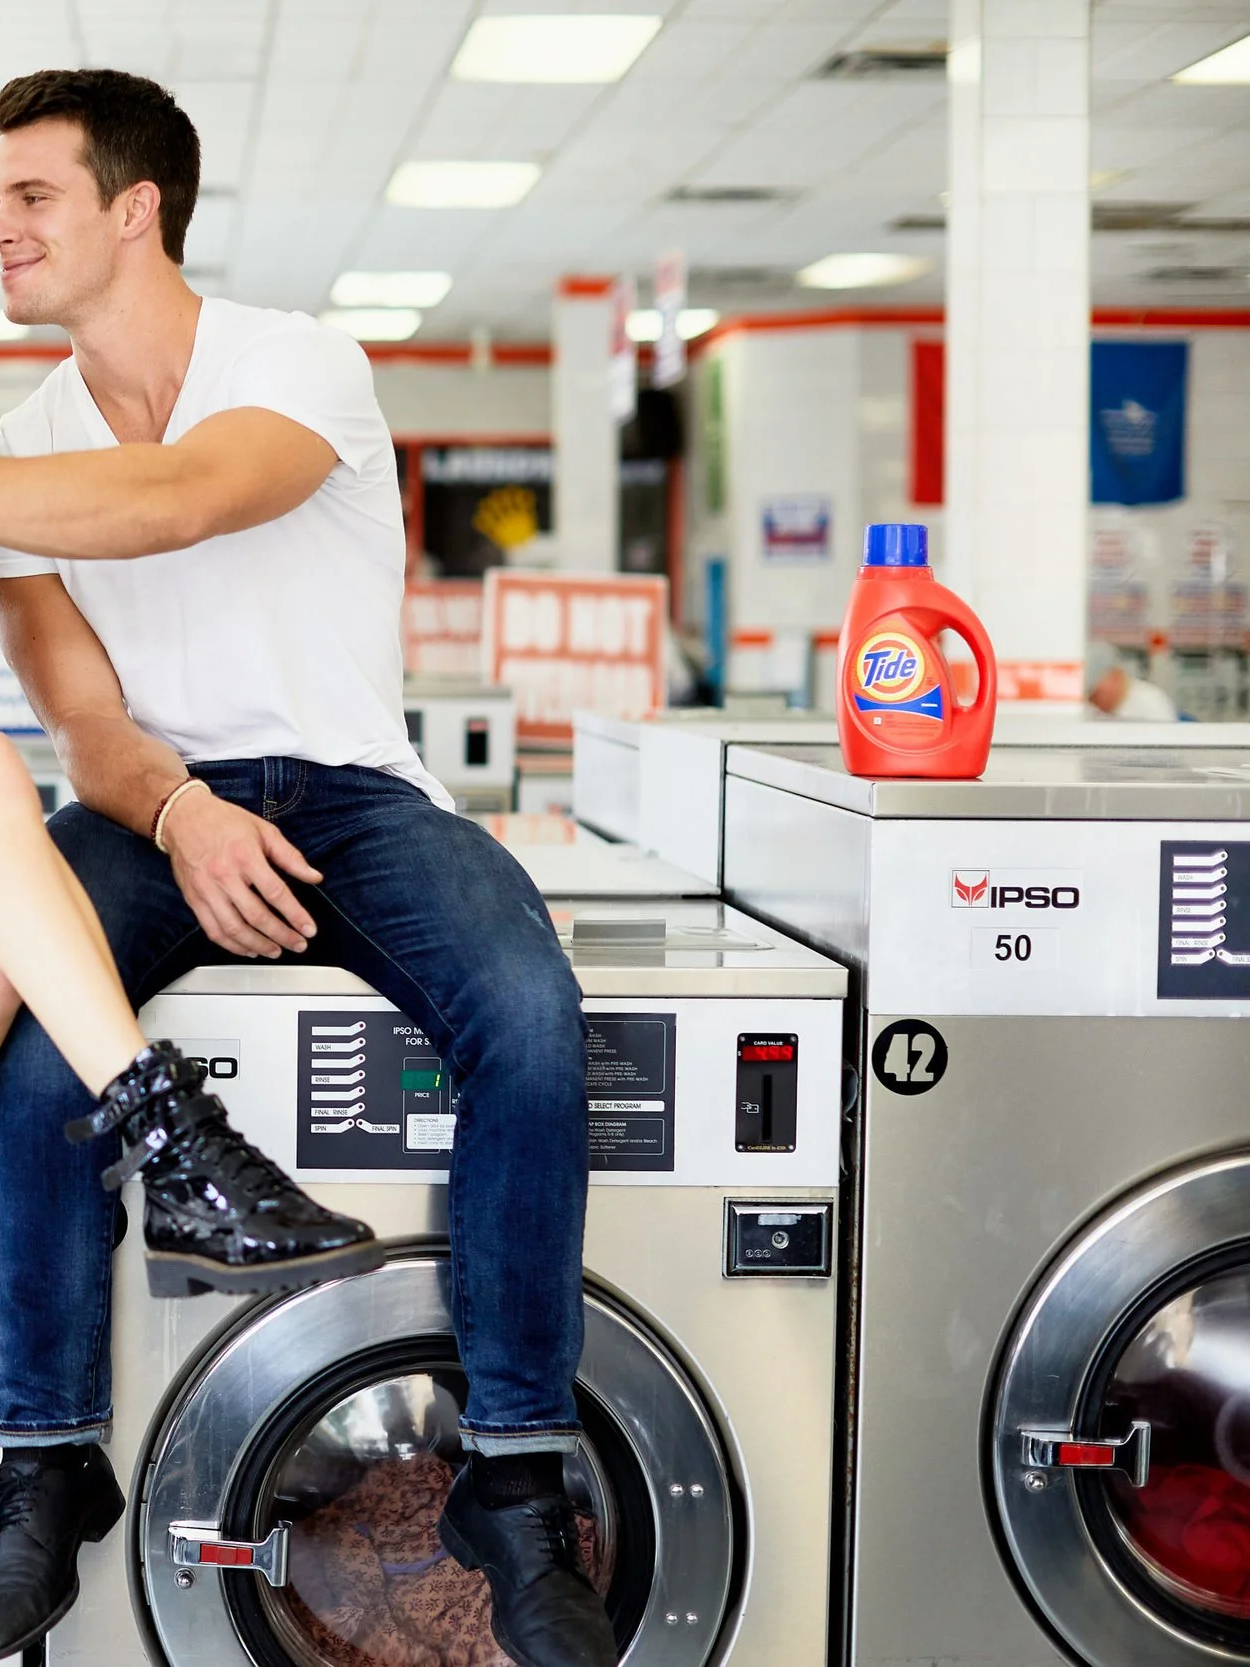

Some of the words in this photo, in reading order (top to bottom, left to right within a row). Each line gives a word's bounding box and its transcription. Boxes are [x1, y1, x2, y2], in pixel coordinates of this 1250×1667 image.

[863, 649, 917, 688] Tide
[990, 886, 1080, 909] IPSO
[994, 934, 1032, 962] 50
[393, 1027, 412, 1035] IPSO
[405, 1038, 422, 1046] FOR
[884, 1033, 936, 1082] 42
